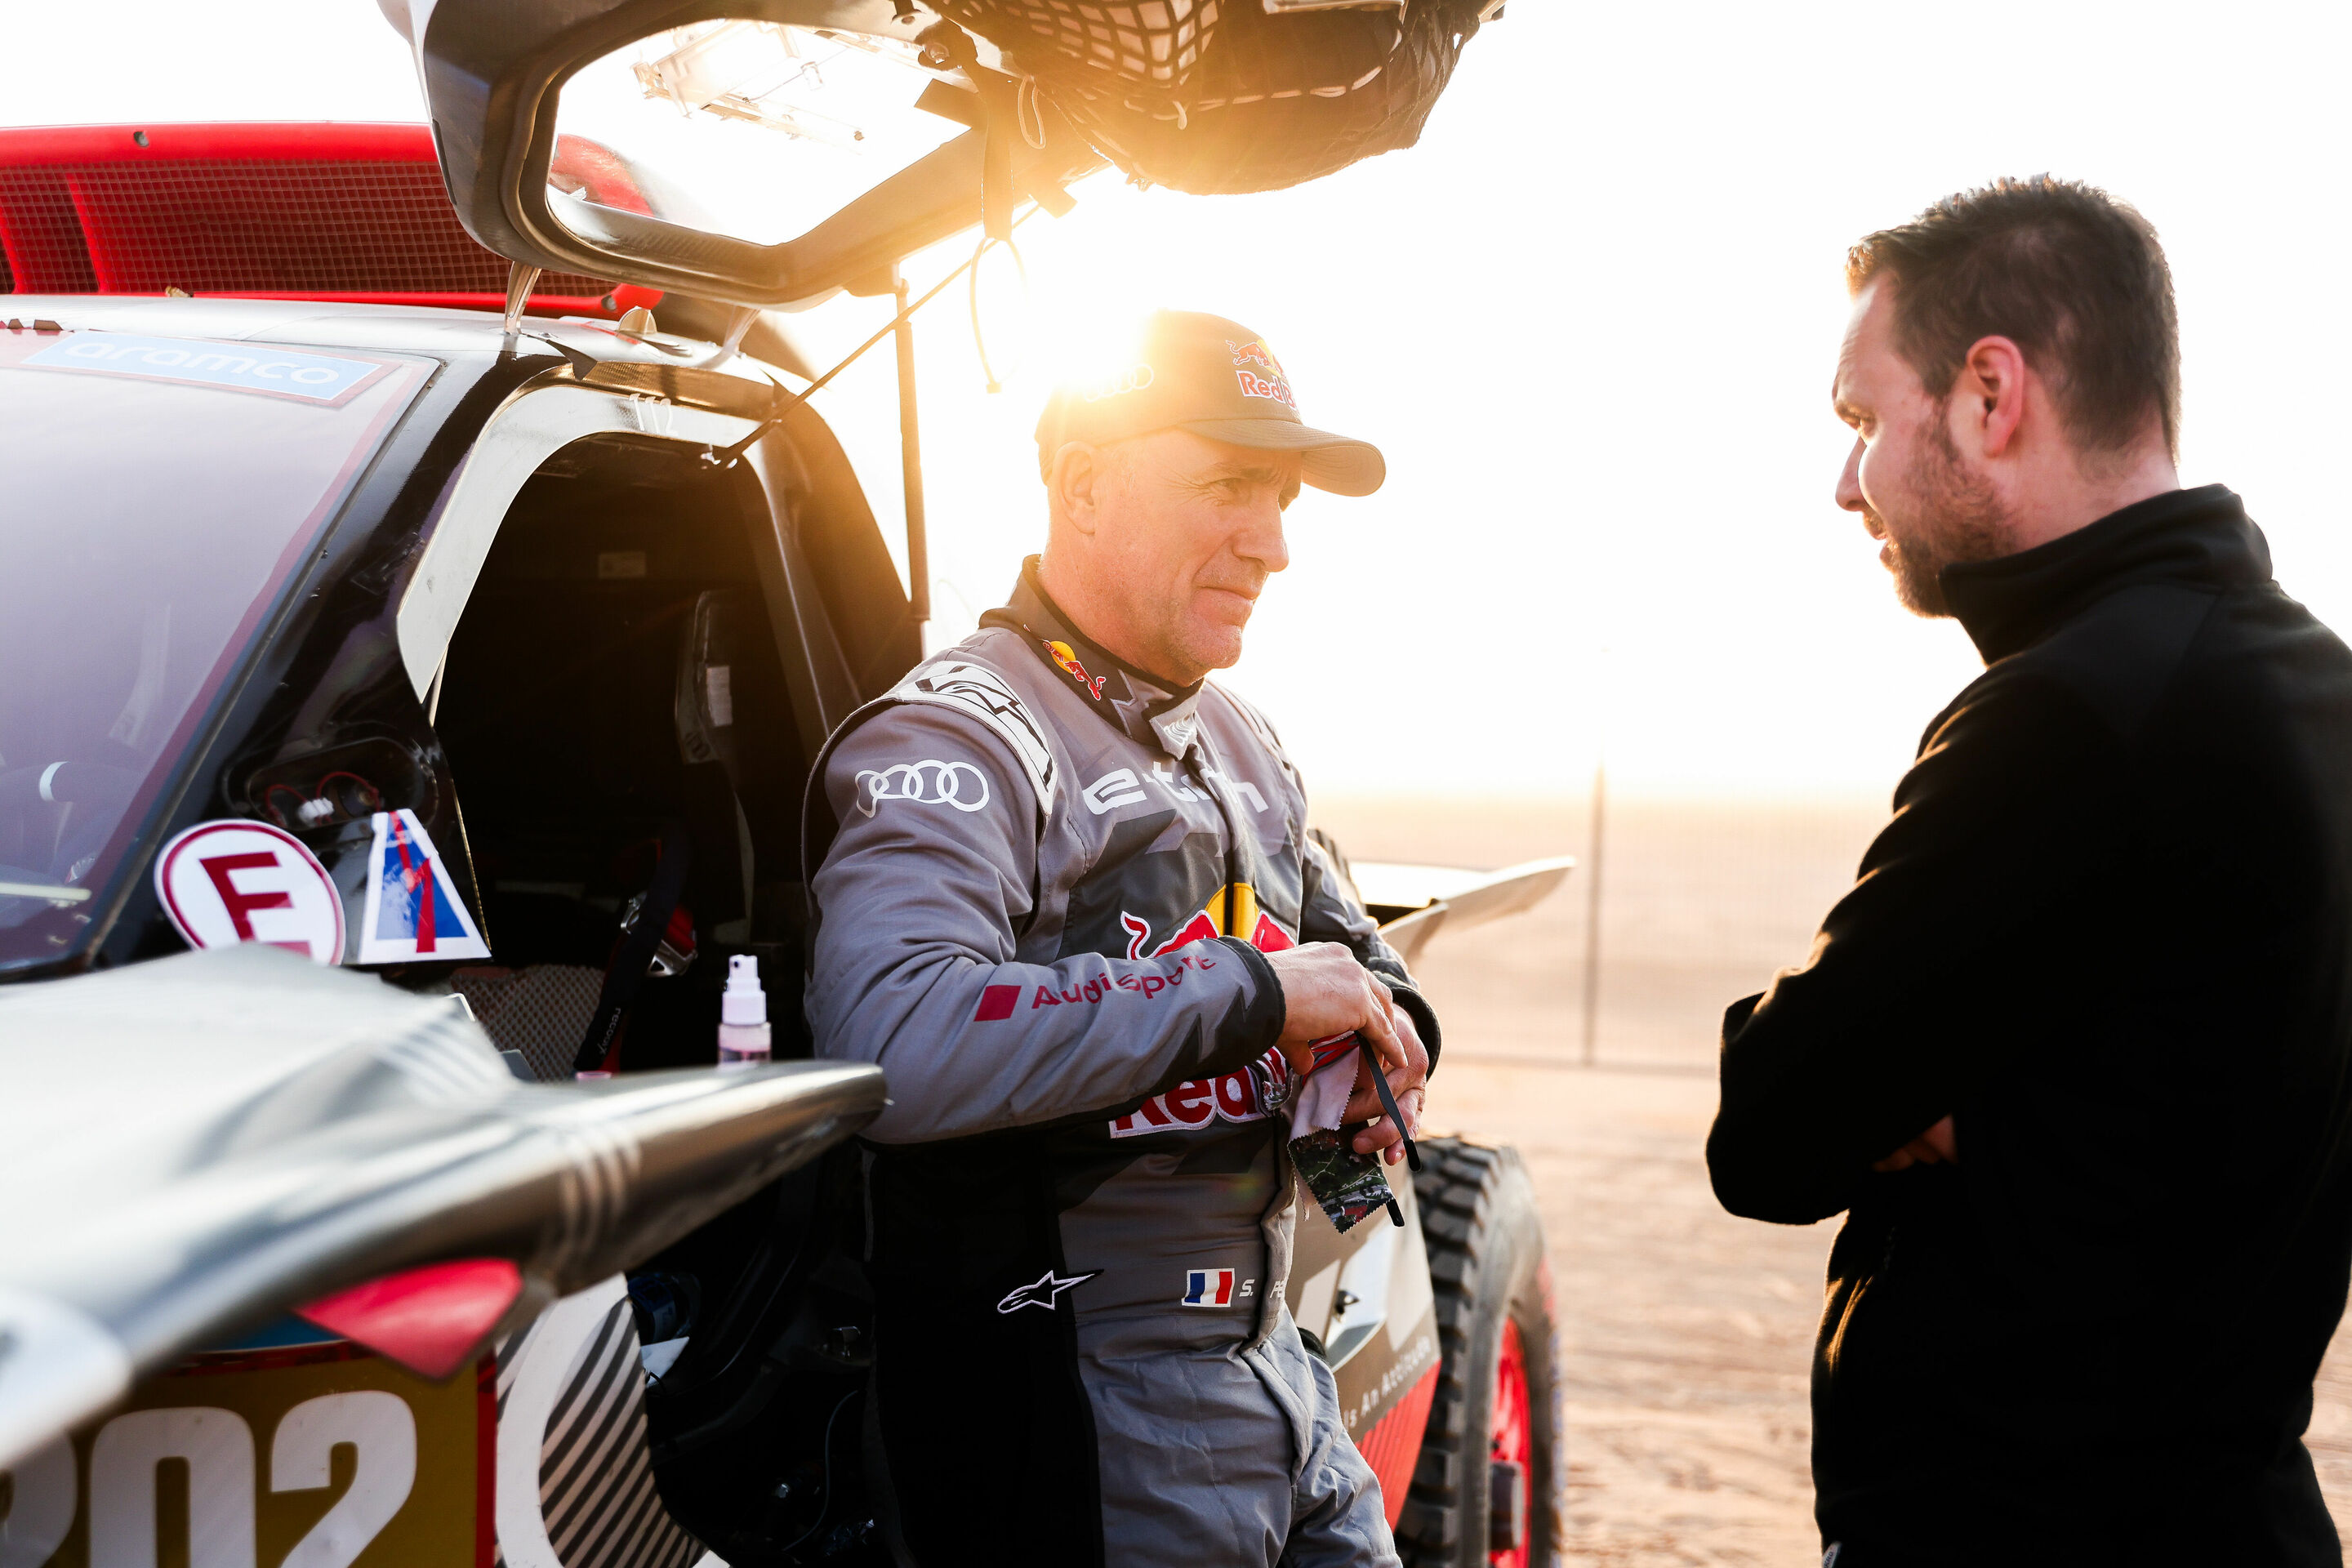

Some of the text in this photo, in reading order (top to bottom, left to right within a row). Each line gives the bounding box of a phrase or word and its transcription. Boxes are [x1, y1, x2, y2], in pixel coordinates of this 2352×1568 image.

[65, 342, 340, 385] aramco
[1236, 370, 1285, 403] Red
[1031, 973, 1112, 1009] Audi
[1239, 1279, 1255, 1297] S.
[1360, 1390, 1380, 1419] An
